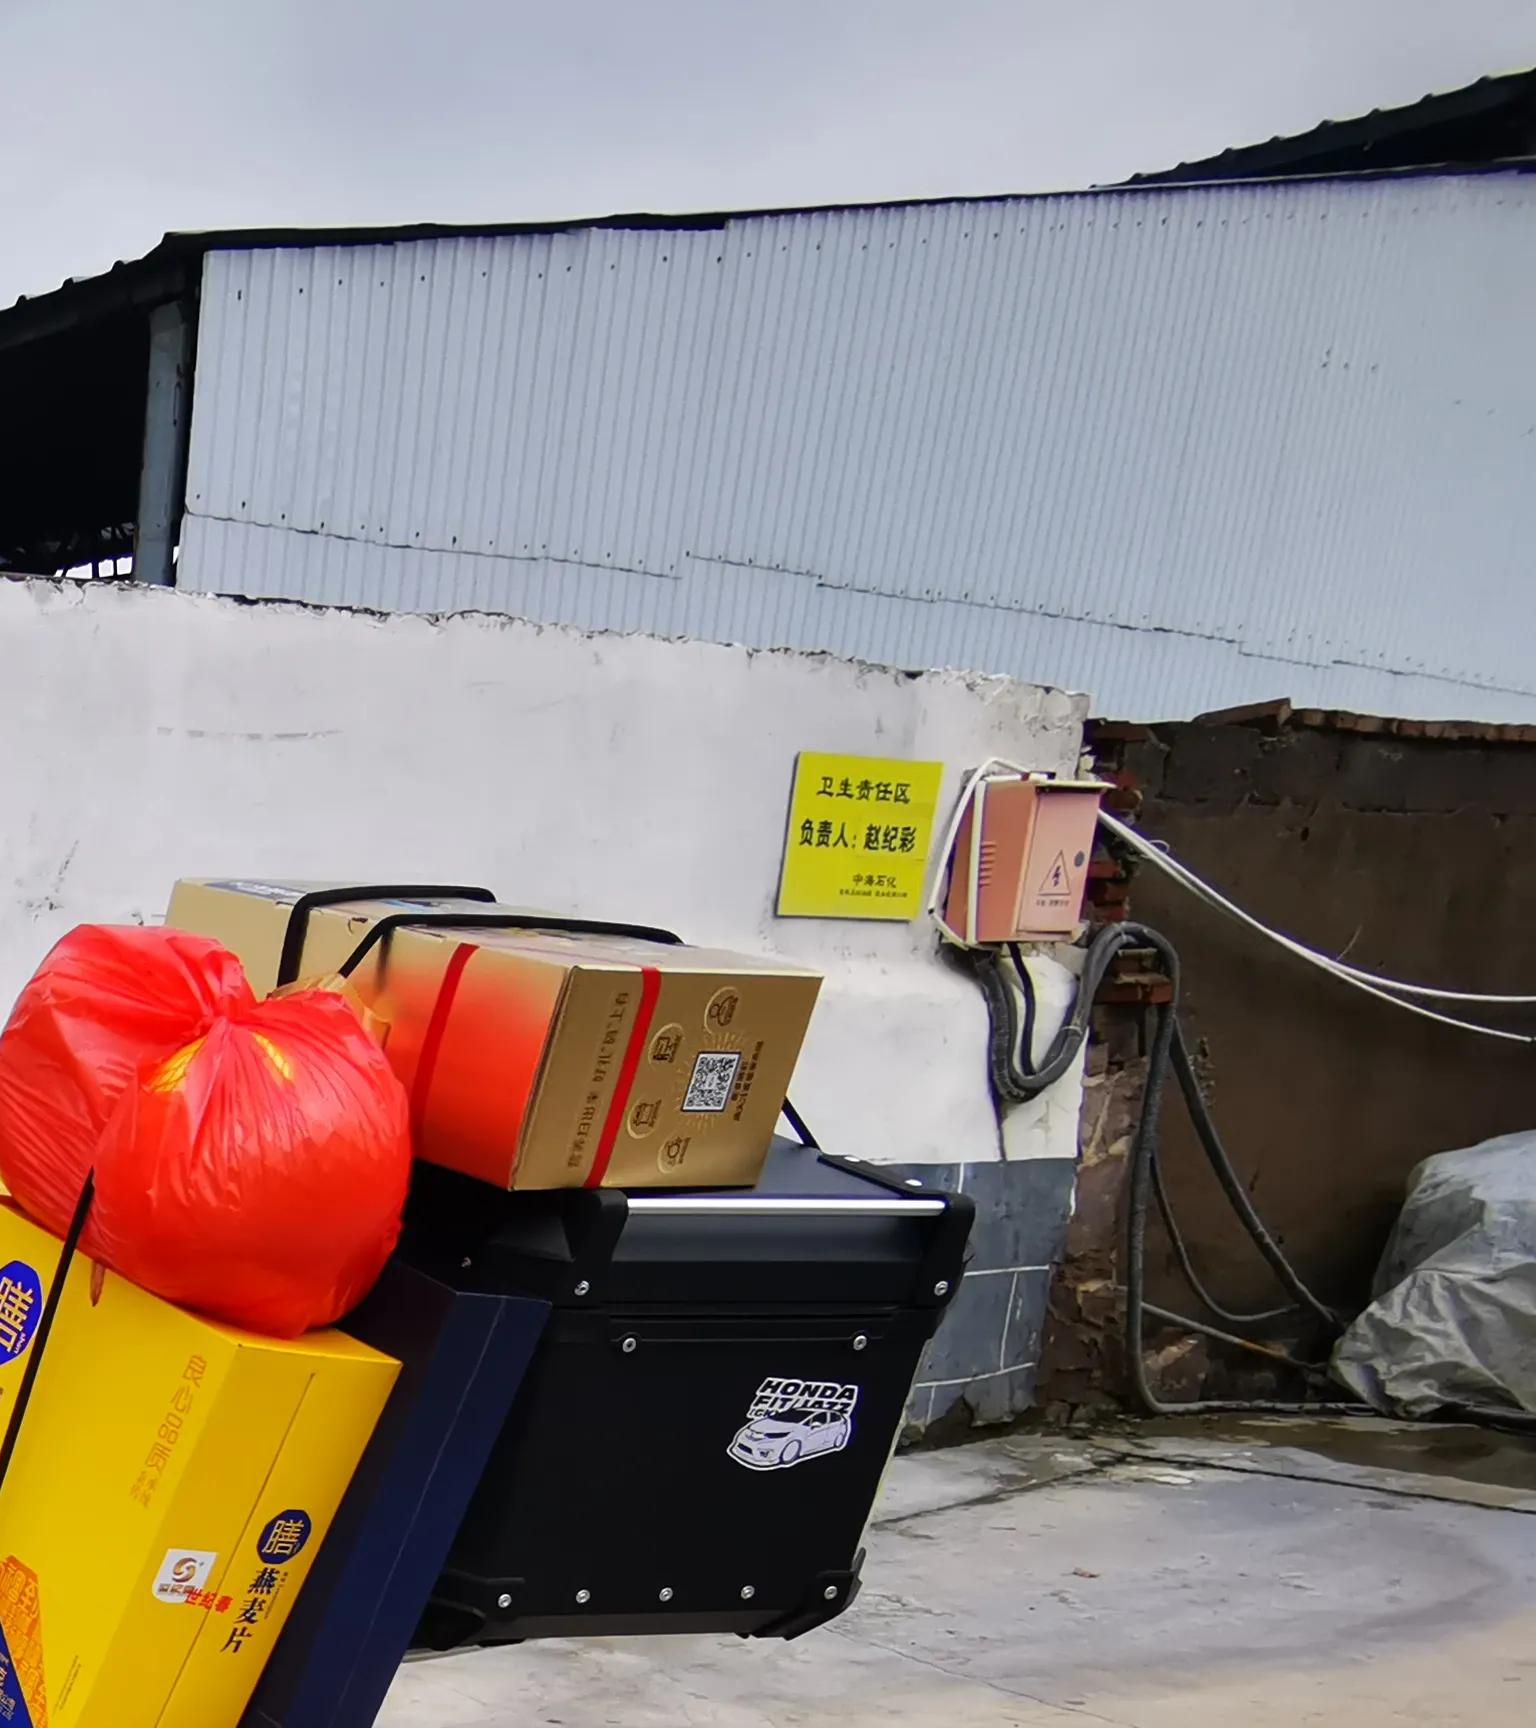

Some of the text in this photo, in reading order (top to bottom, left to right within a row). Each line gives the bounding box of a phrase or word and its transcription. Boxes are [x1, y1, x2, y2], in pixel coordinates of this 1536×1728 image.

[816, 776, 912, 804] 卫生责任区
[759, 1379, 856, 1401] HONDA
[220, 1567, 280, 1653] 燕麦片
